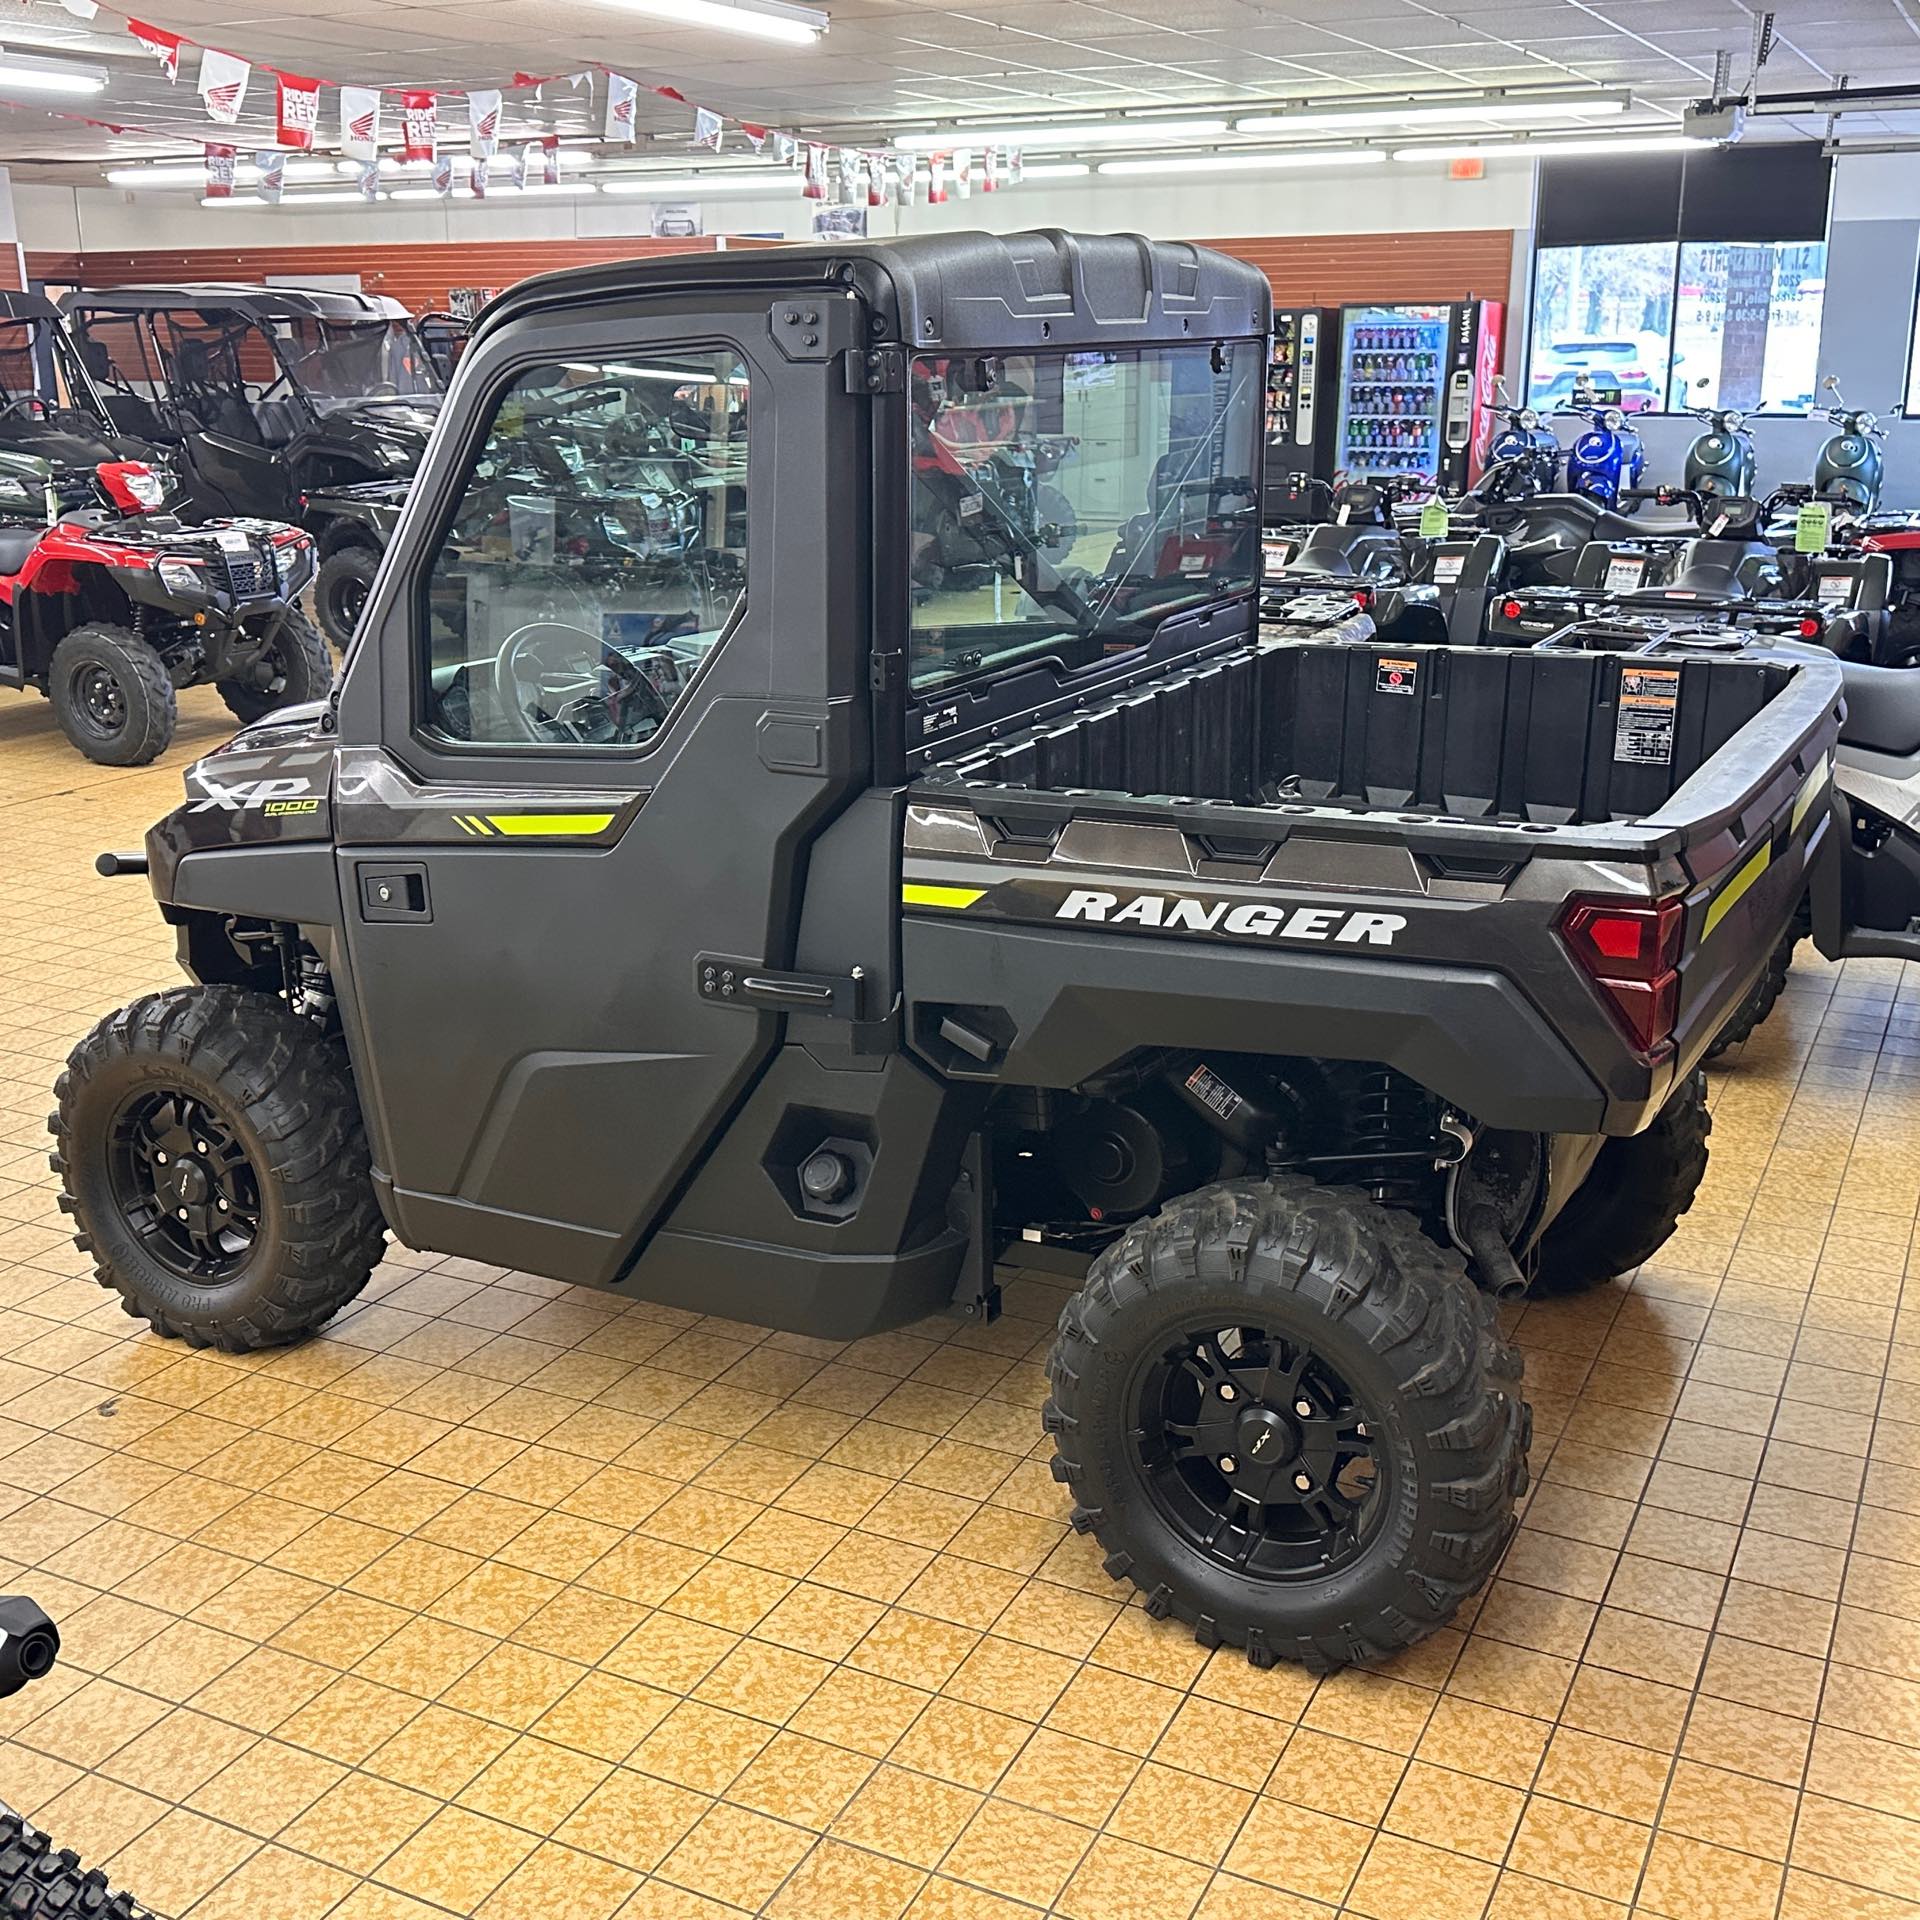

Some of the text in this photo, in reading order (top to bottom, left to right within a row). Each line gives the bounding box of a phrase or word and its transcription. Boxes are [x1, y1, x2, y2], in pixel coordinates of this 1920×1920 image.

[283, 87, 314, 106] RIDE
[283, 101, 316, 123] RED
[405, 108, 434, 121] RIDE
[207, 156, 233, 167] RIDE
[1461, 308, 1472, 343] DASANI
[187, 777, 312, 813] XP
[264, 800, 319, 812] 1000
[1055, 889, 1407, 946] RANGER
[1251, 1428, 1271, 1454] XP
